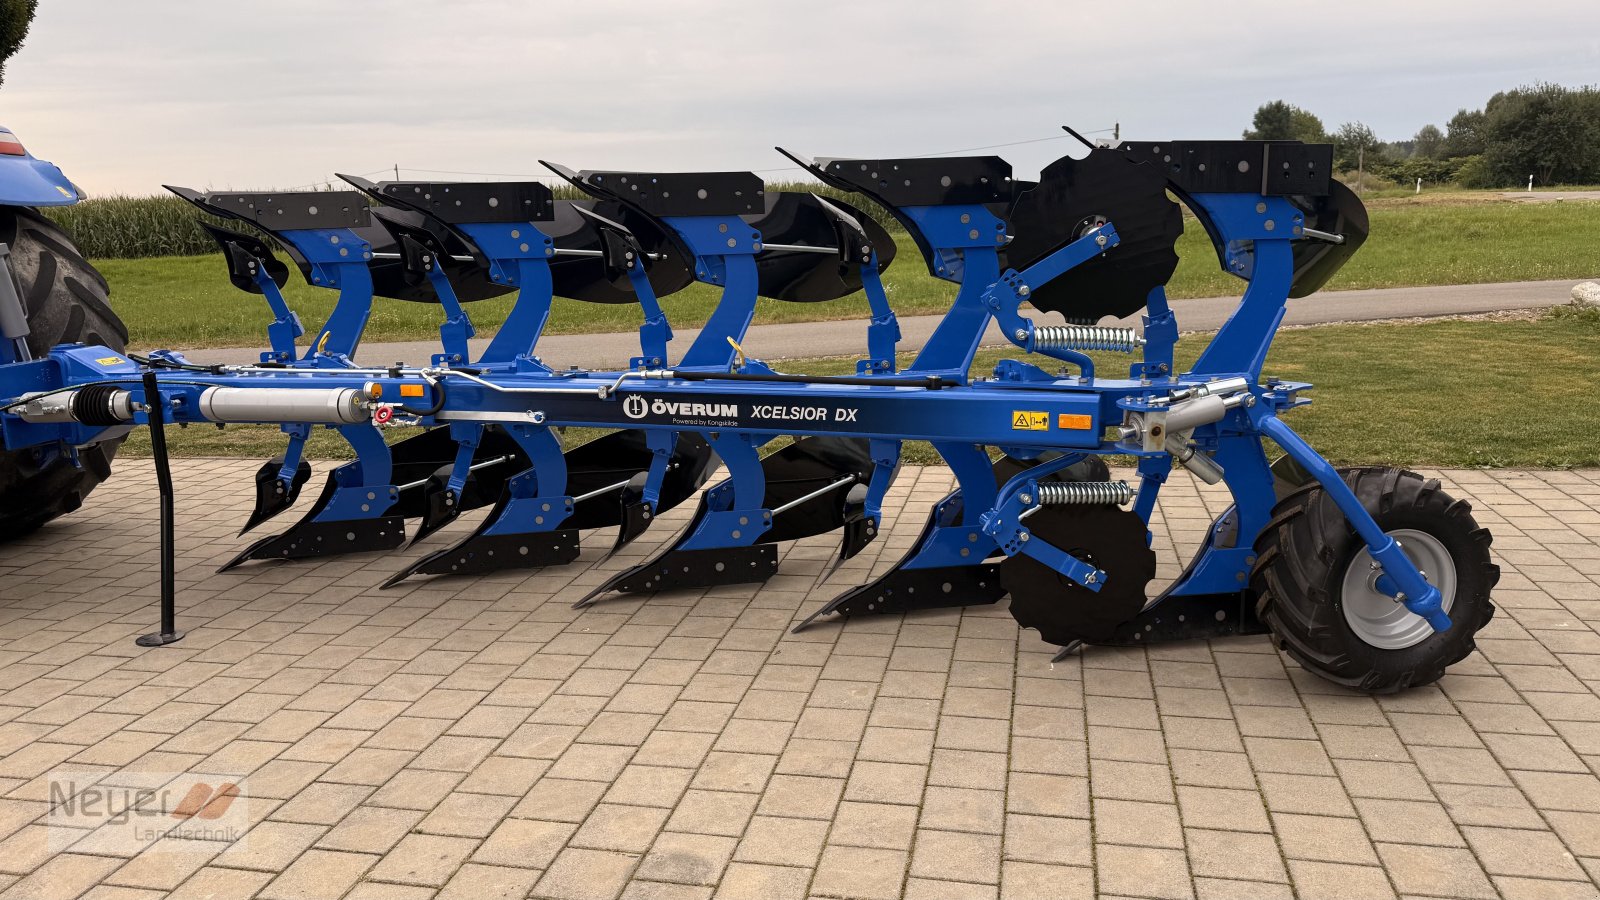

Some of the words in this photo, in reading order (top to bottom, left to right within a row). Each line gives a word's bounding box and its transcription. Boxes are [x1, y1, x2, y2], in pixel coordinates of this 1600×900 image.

[651, 399, 738, 417] ÖVERUM
[751, 405, 827, 421] XCELSIOR
[834, 408, 858, 422] DX
[699, 418, 706, 426] by
[707, 419, 738, 427] Kongskilde
